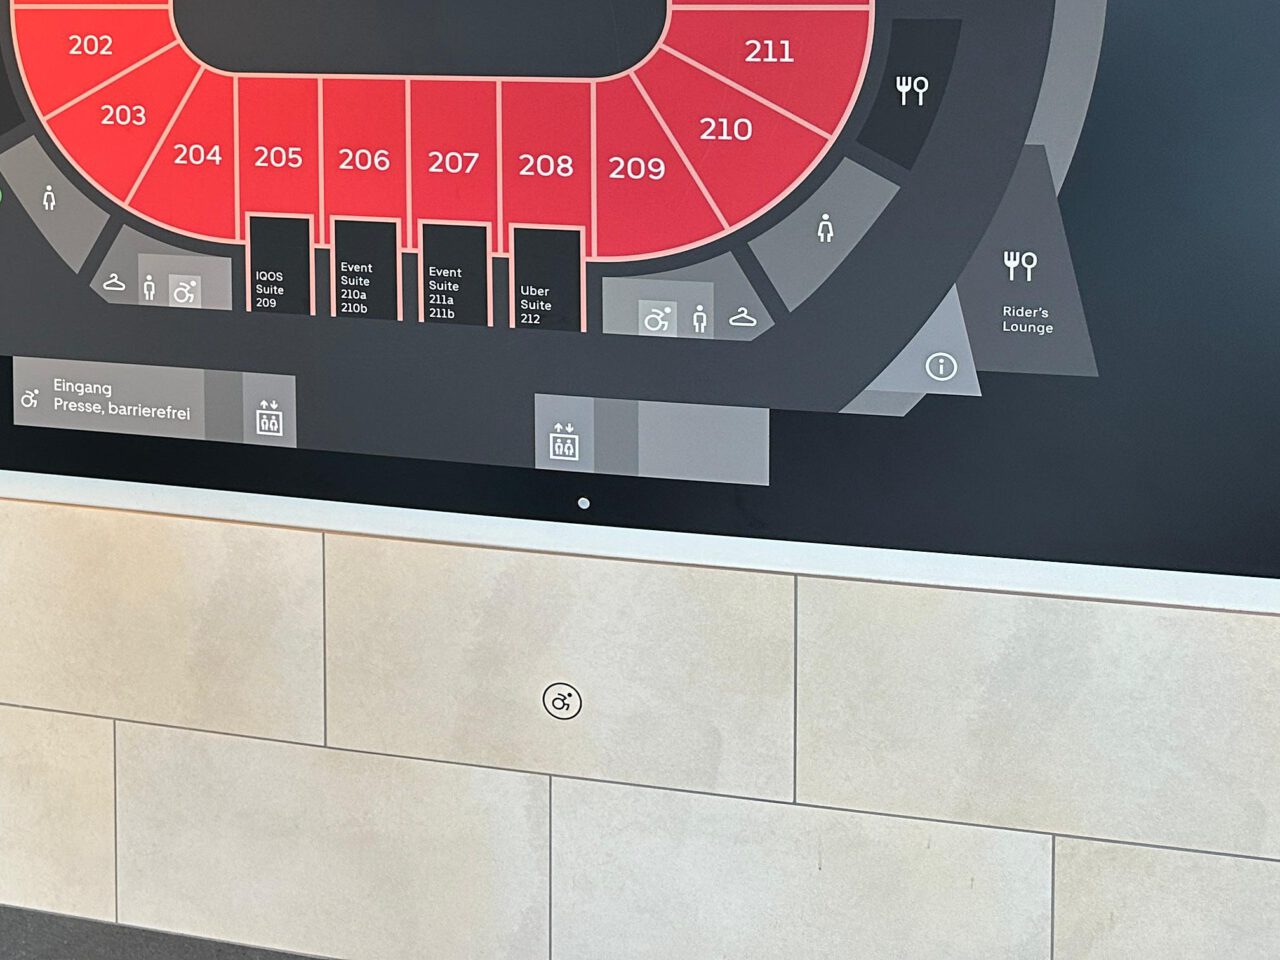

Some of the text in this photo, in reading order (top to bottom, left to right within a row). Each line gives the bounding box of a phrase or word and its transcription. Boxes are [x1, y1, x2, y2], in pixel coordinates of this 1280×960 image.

[69, 34, 113, 55] 202
[745, 39, 794, 63] 211
[101, 104, 146, 126] 203
[700, 117, 753, 141] 210
[174, 143, 222, 165] 204
[254, 146, 303, 168] 205
[339, 148, 390, 171] 206
[428, 151, 480, 174] 207
[519, 153, 574, 177] 208
[609, 156, 666, 180] 209
[341, 261, 373, 273] Event
[429, 266, 462, 278] Event
[256, 271, 284, 282] IQOS
[340, 275, 370, 287] Suite
[256, 284, 284, 295] Suite
[428, 280, 459, 292] Suite
[520, 285, 550, 297] Uber
[341, 288, 367, 300] 210a
[429, 294, 454, 305] 211a
[256, 297, 277, 308] 209
[341, 302, 368, 314] 210b
[520, 299, 552, 311] Suite
[429, 307, 455, 319] 211b
[1003, 306, 1049, 318] Rider's
[520, 313, 541, 324] 212
[1003, 320, 1054, 336] Lounge
[54, 378, 112, 398] Eingang
[54, 397, 190, 421] Presse, barrierefrei
